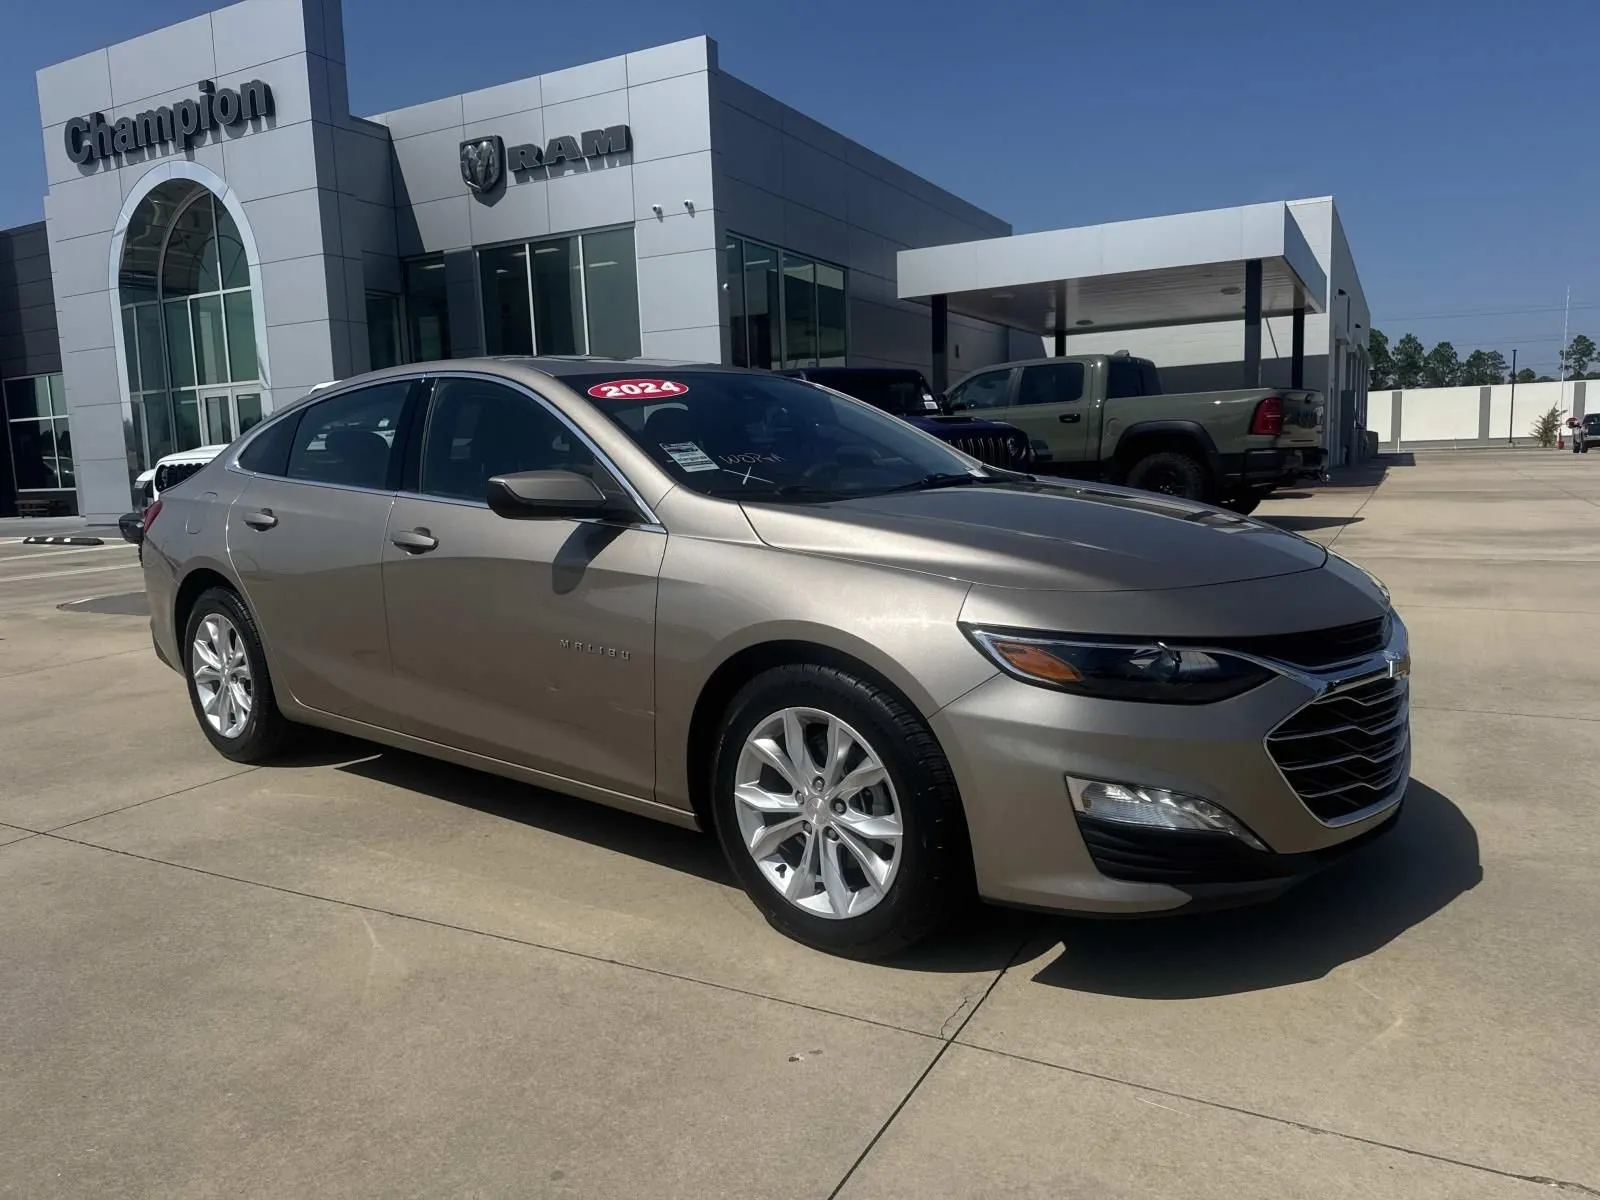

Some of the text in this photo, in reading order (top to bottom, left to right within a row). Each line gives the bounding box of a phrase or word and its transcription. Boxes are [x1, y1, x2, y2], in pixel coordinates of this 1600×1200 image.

[64, 79, 266, 164] Champion
[506, 124, 630, 172] RAM
[600, 381, 681, 398] 2024
[559, 639, 631, 661] MALIBU
